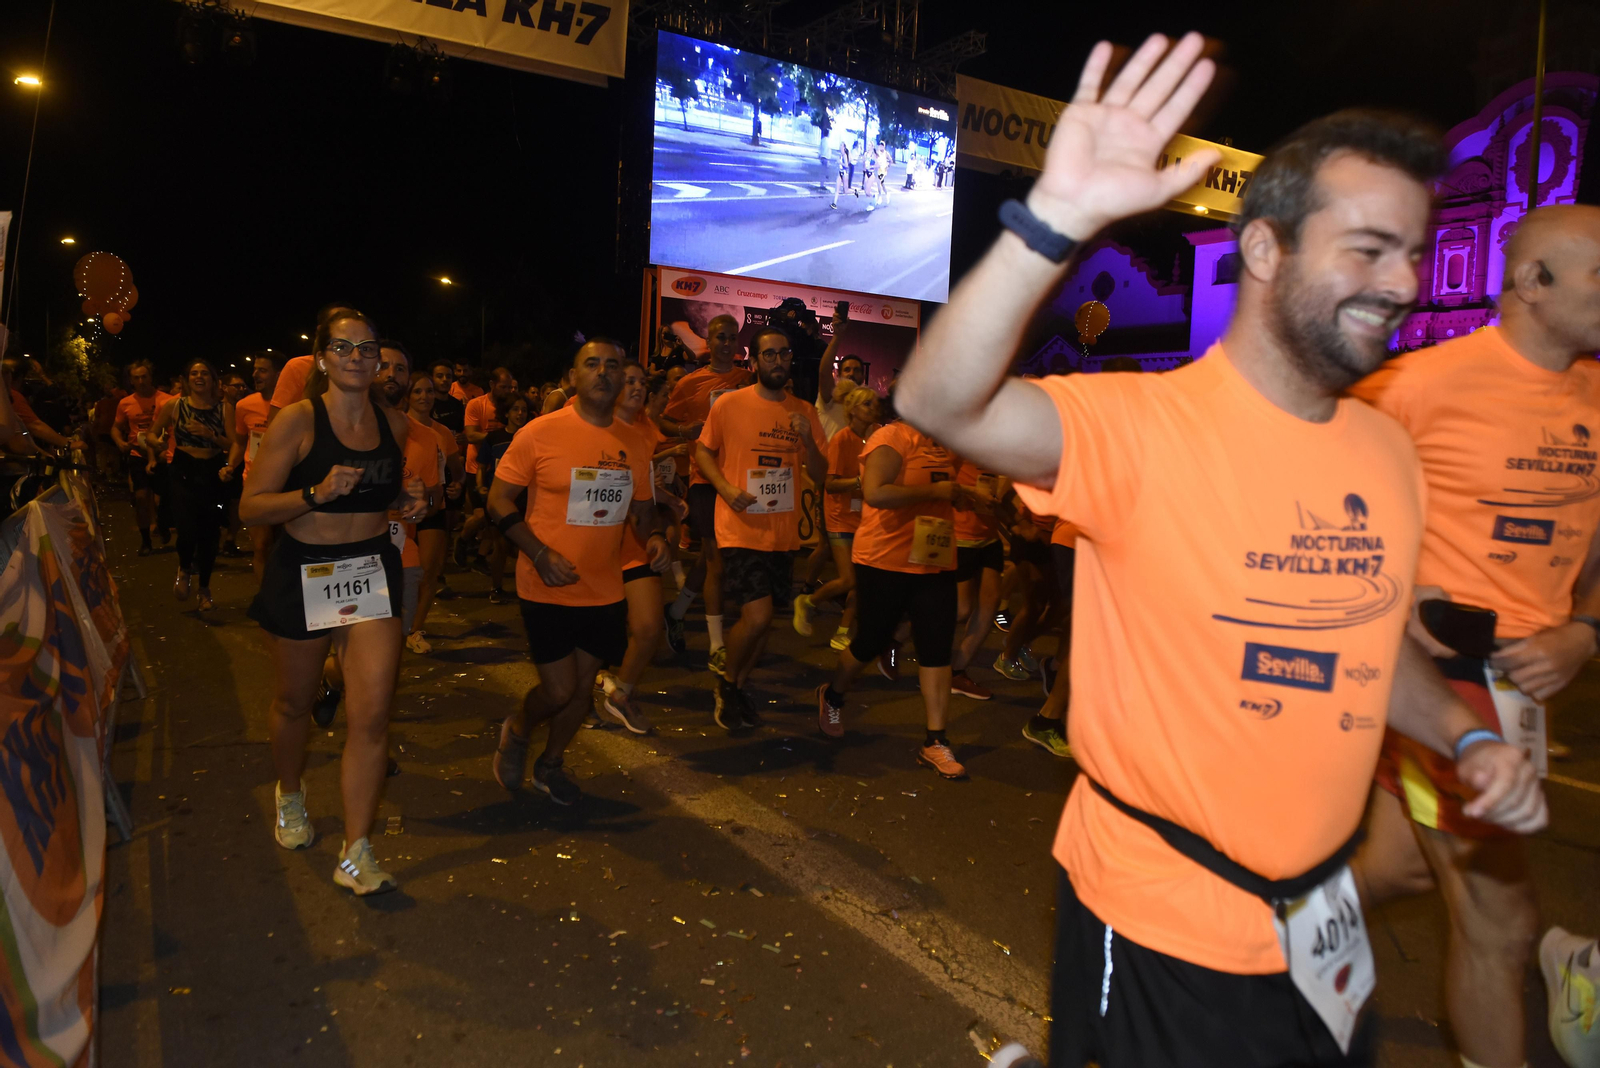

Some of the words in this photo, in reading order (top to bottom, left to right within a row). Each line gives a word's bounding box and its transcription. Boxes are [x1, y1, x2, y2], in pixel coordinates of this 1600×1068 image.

[962, 103, 1054, 149] NOCTU
[714, 285, 730, 293] ABC
[737, 289, 768, 299] Cruzcampo
[759, 431, 784, 440] SEVILLA
[1538, 446, 1598, 461] NOCTURNA
[1506, 457, 1564, 473] SEVILLA
[585, 488, 622, 503] 11686
[759, 483, 787, 495] 15811
[1291, 534, 1385, 552] NOCTURNA
[1245, 551, 1332, 575] SEVILLA
[323, 578, 371, 600] 11161
